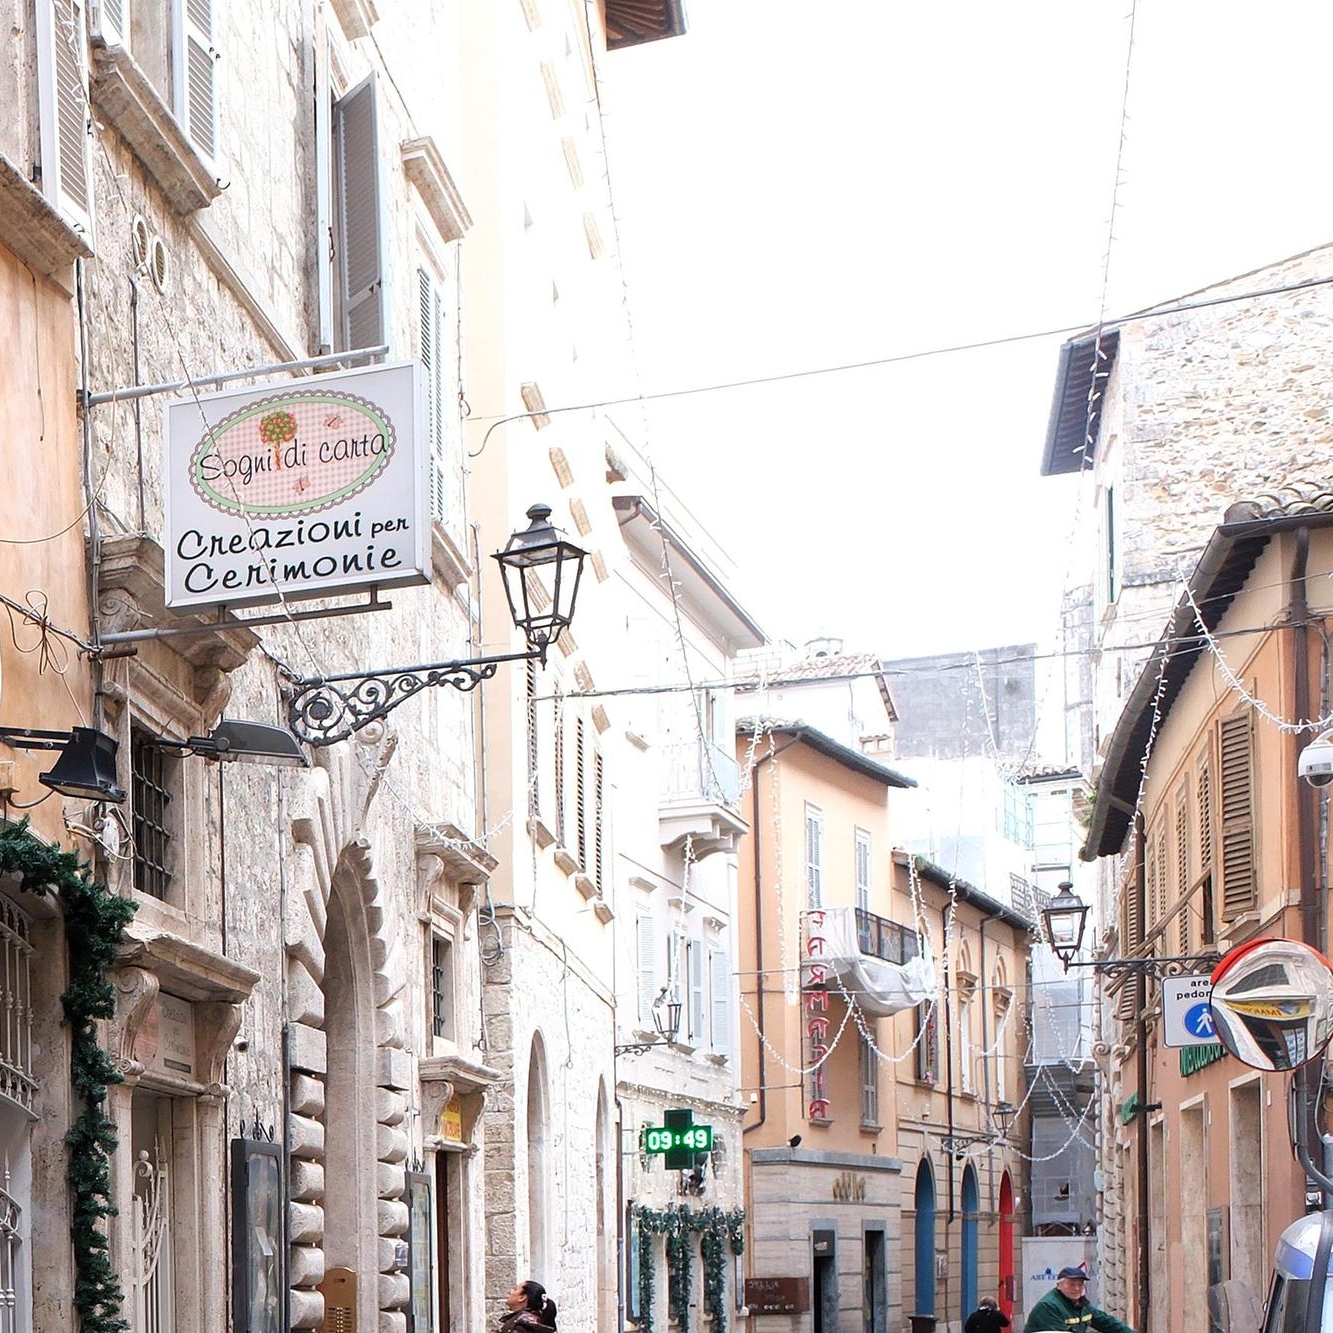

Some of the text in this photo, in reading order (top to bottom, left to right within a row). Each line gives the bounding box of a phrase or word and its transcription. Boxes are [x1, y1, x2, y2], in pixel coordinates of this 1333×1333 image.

[199, 432, 388, 485] Sogni di carta
[176, 511, 410, 562] Creazioni per
[184, 545, 403, 593] Cerimonie
[647, 1129, 708, 1151] 09:49
